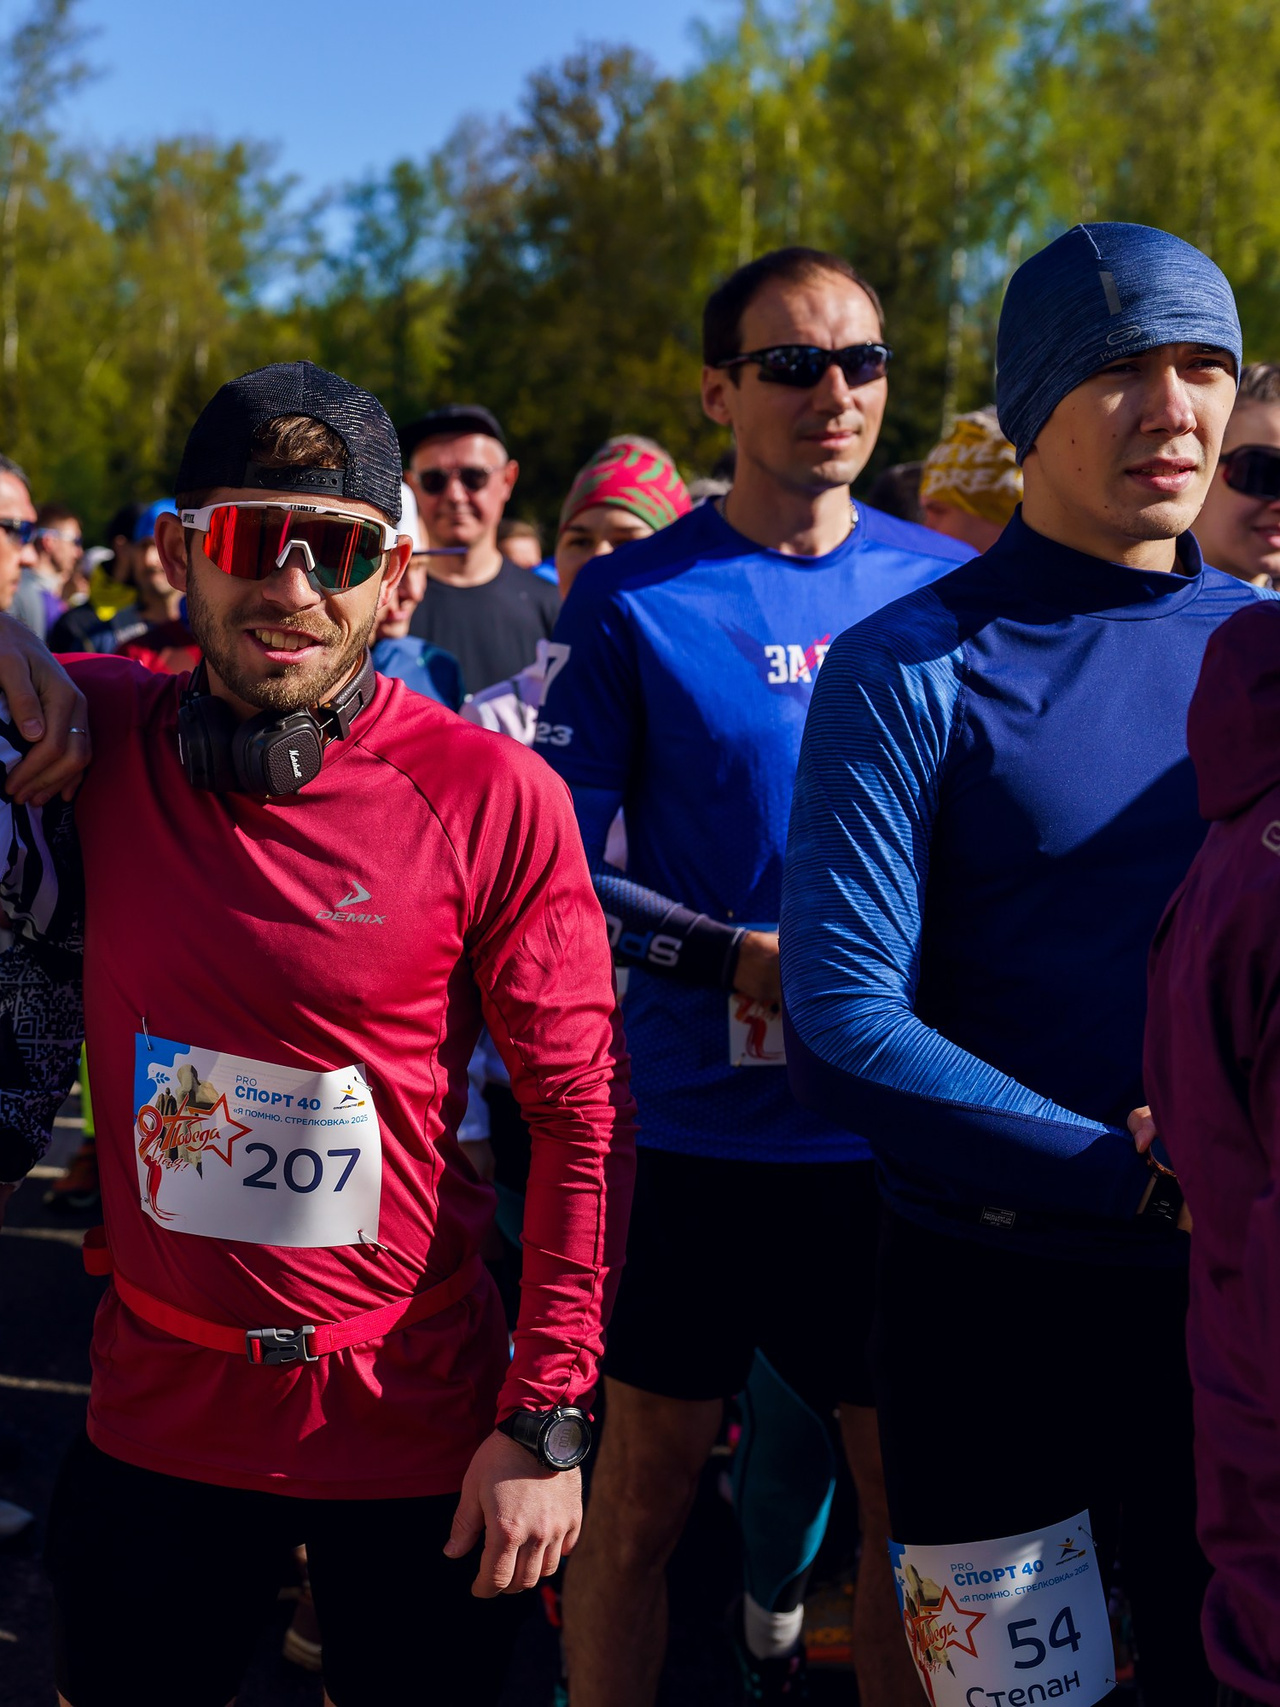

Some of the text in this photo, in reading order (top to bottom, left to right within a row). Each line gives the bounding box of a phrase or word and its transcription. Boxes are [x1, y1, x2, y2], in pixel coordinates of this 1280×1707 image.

[315, 910, 387, 924] DEMIX
[235, 1075, 257, 1087] PRO
[235, 1085, 295, 1108] СПОРТ
[297, 1097, 321, 1111] 40
[233, 1107, 243, 1115] «Я
[284, 1115, 350, 1127] СТРЕЛКОВКА»
[351, 1114, 369, 1124] 2025
[160, 1114, 222, 1152] Победа
[242, 1142, 361, 1193] 207
[951, 1563, 974, 1573] PRO
[954, 1560, 1045, 1587] СПОРТ 40
[1014, 1572, 1074, 1596] СТРЕЛКОВКА»
[1074, 1562, 1090, 1576] 2025
[1007, 1606, 1081, 1669] 54
[966, 1671, 1081, 1707] Степан
